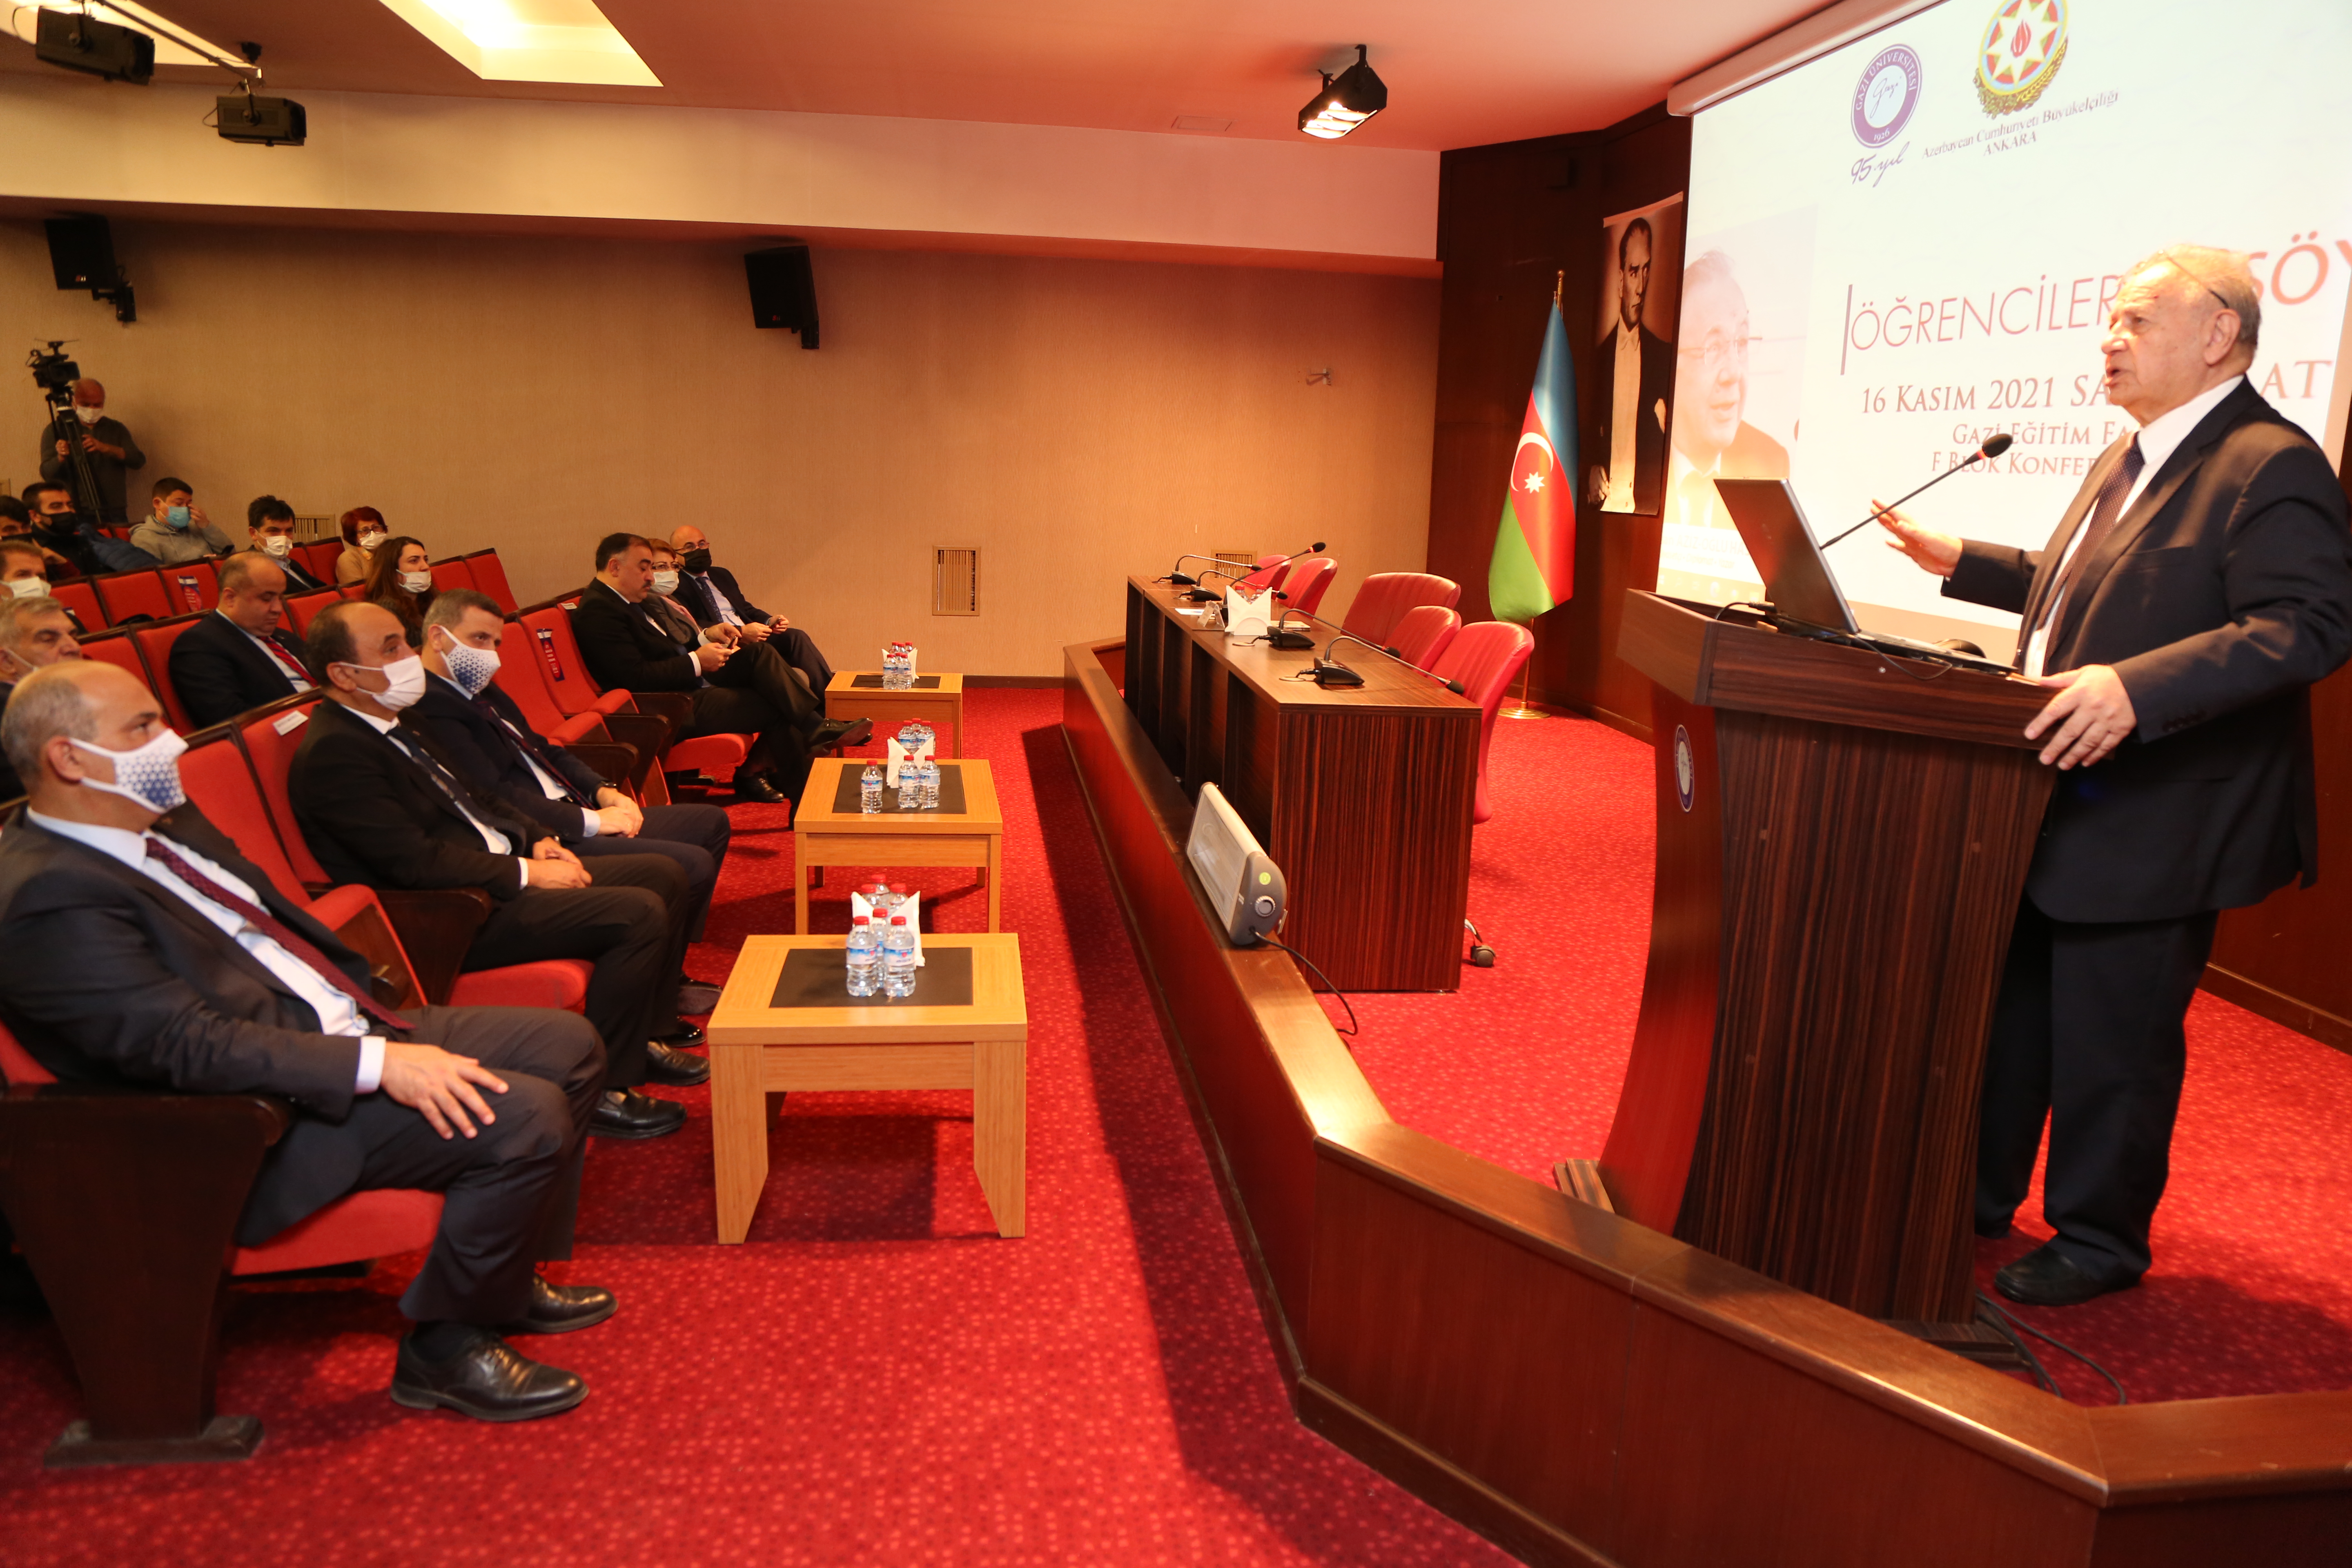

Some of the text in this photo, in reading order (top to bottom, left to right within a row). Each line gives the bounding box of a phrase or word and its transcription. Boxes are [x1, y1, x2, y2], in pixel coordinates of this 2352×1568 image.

[1873, 129, 1890, 143] 1926
[1922, 136, 1974, 159] Azerbaycan
[1983, 131, 2037, 156] ANKARA
[1862, 387, 1886, 413] 16
[1896, 385, 1976, 412] KASIM
[1988, 377, 2053, 410] 2021
[2011, 421, 2090, 444] EĞİTİM
[1931, 451, 1941, 472] F
